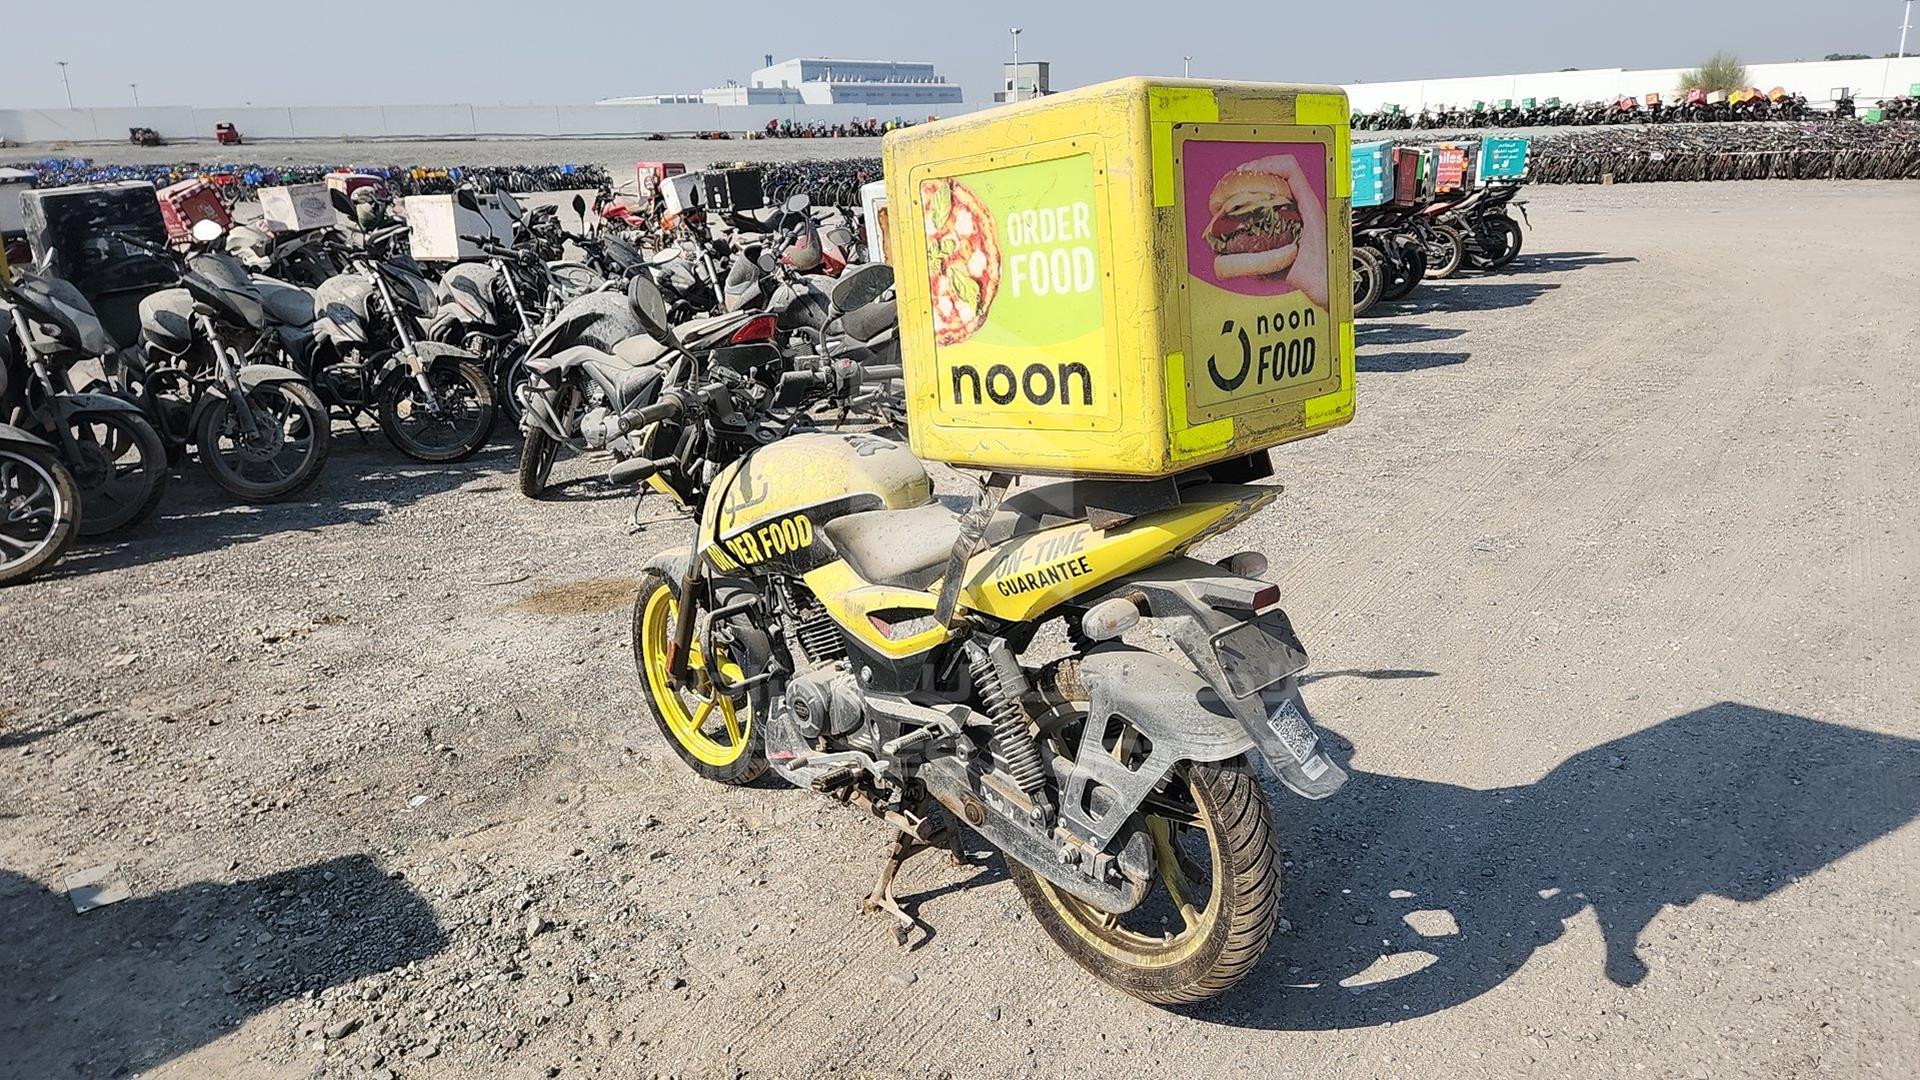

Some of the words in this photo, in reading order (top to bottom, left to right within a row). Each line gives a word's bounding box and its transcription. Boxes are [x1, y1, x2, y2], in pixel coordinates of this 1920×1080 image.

[1007, 201, 1091, 247] ORDER
[1010, 246, 1095, 298] FOOD
[1257, 307, 1315, 335] noon
[951, 361, 1093, 405] noon
[1257, 336, 1316, 385] FOOD
[757, 514, 813, 559] FOOD
[994, 528, 1090, 579] ON-TIME
[997, 556, 1093, 597] GUARANTEE
